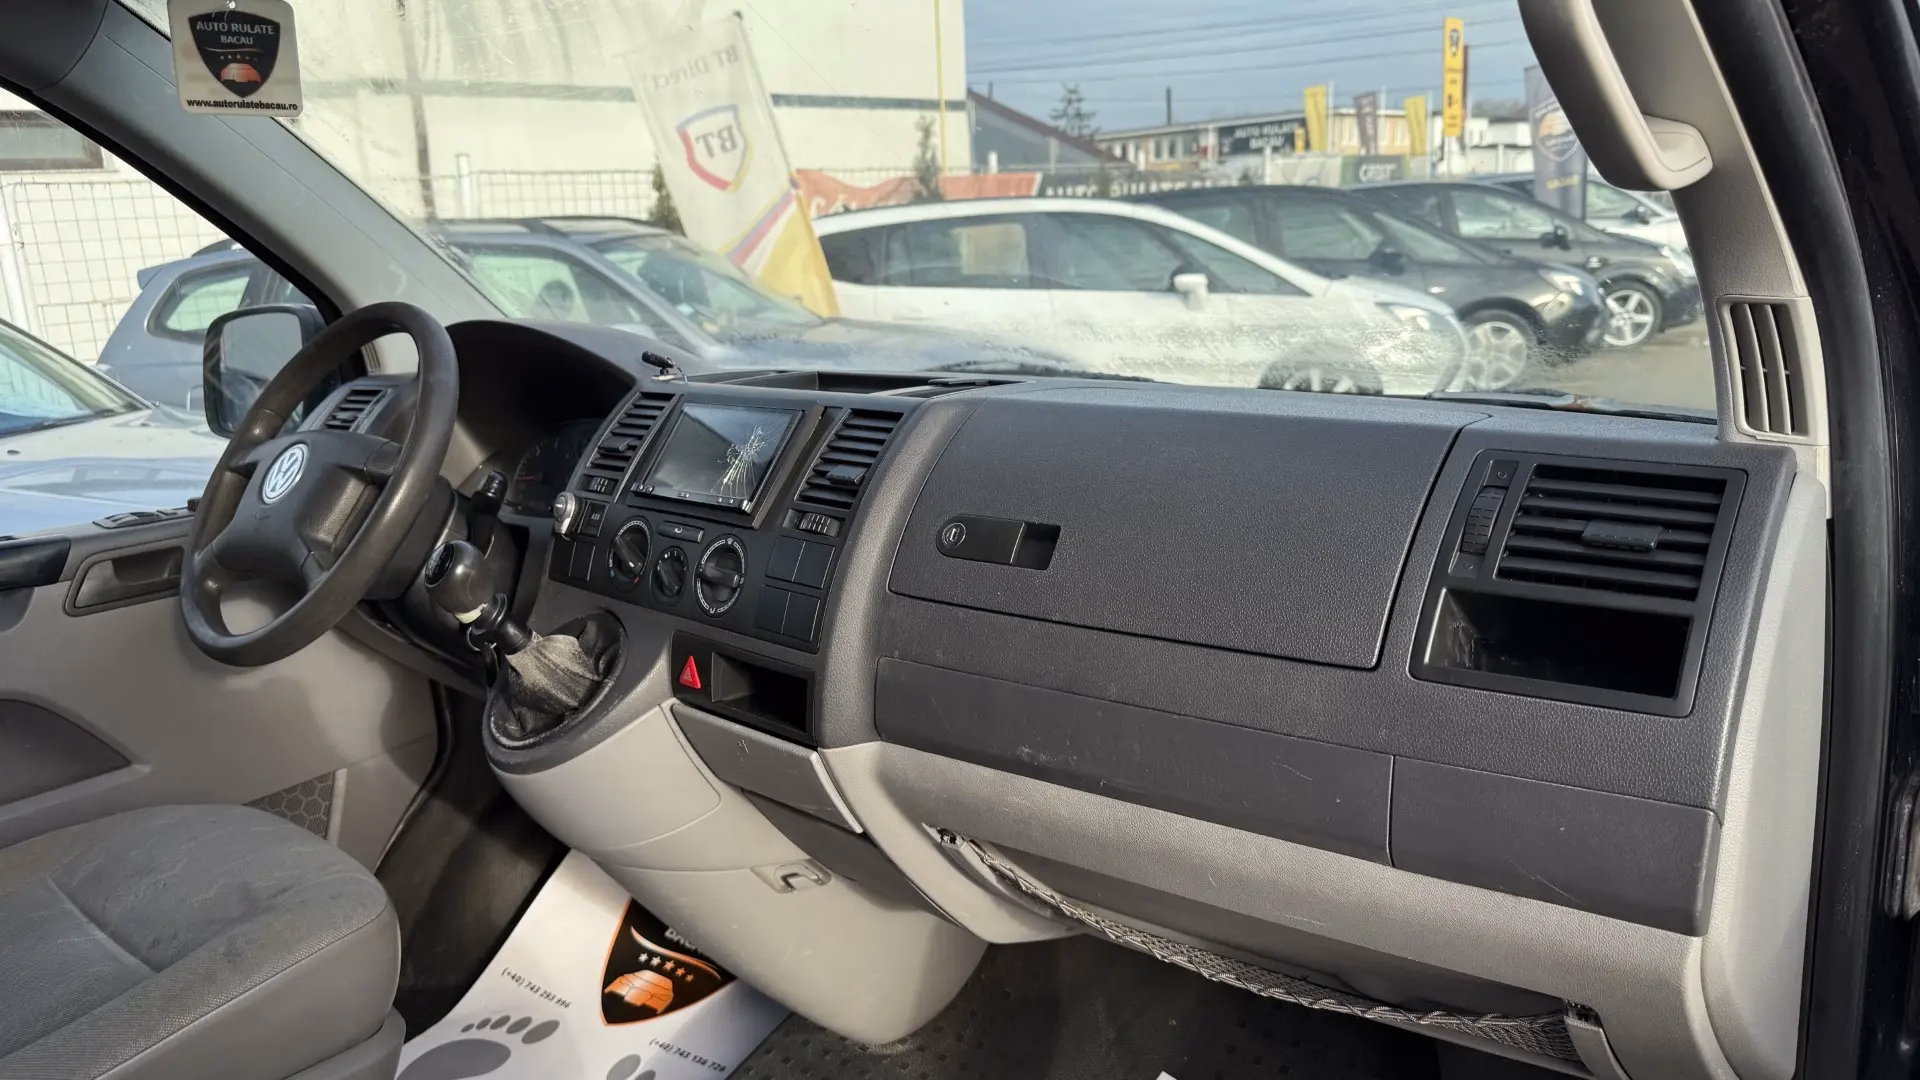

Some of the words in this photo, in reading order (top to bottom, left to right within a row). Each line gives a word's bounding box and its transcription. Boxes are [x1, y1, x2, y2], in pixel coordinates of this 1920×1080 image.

[196, 21, 228, 32] AUTO
[231, 23, 275, 35] RULATE
[221, 35, 253, 44] BACAU
[187, 99, 298, 110] www.autorulatebacau.ro
[501, 967, 525, 986] (+40)
[524, 981, 541, 994] 743
[649, 1037, 674, 1053] (+40)
[673, 1047, 691, 1059] 743
